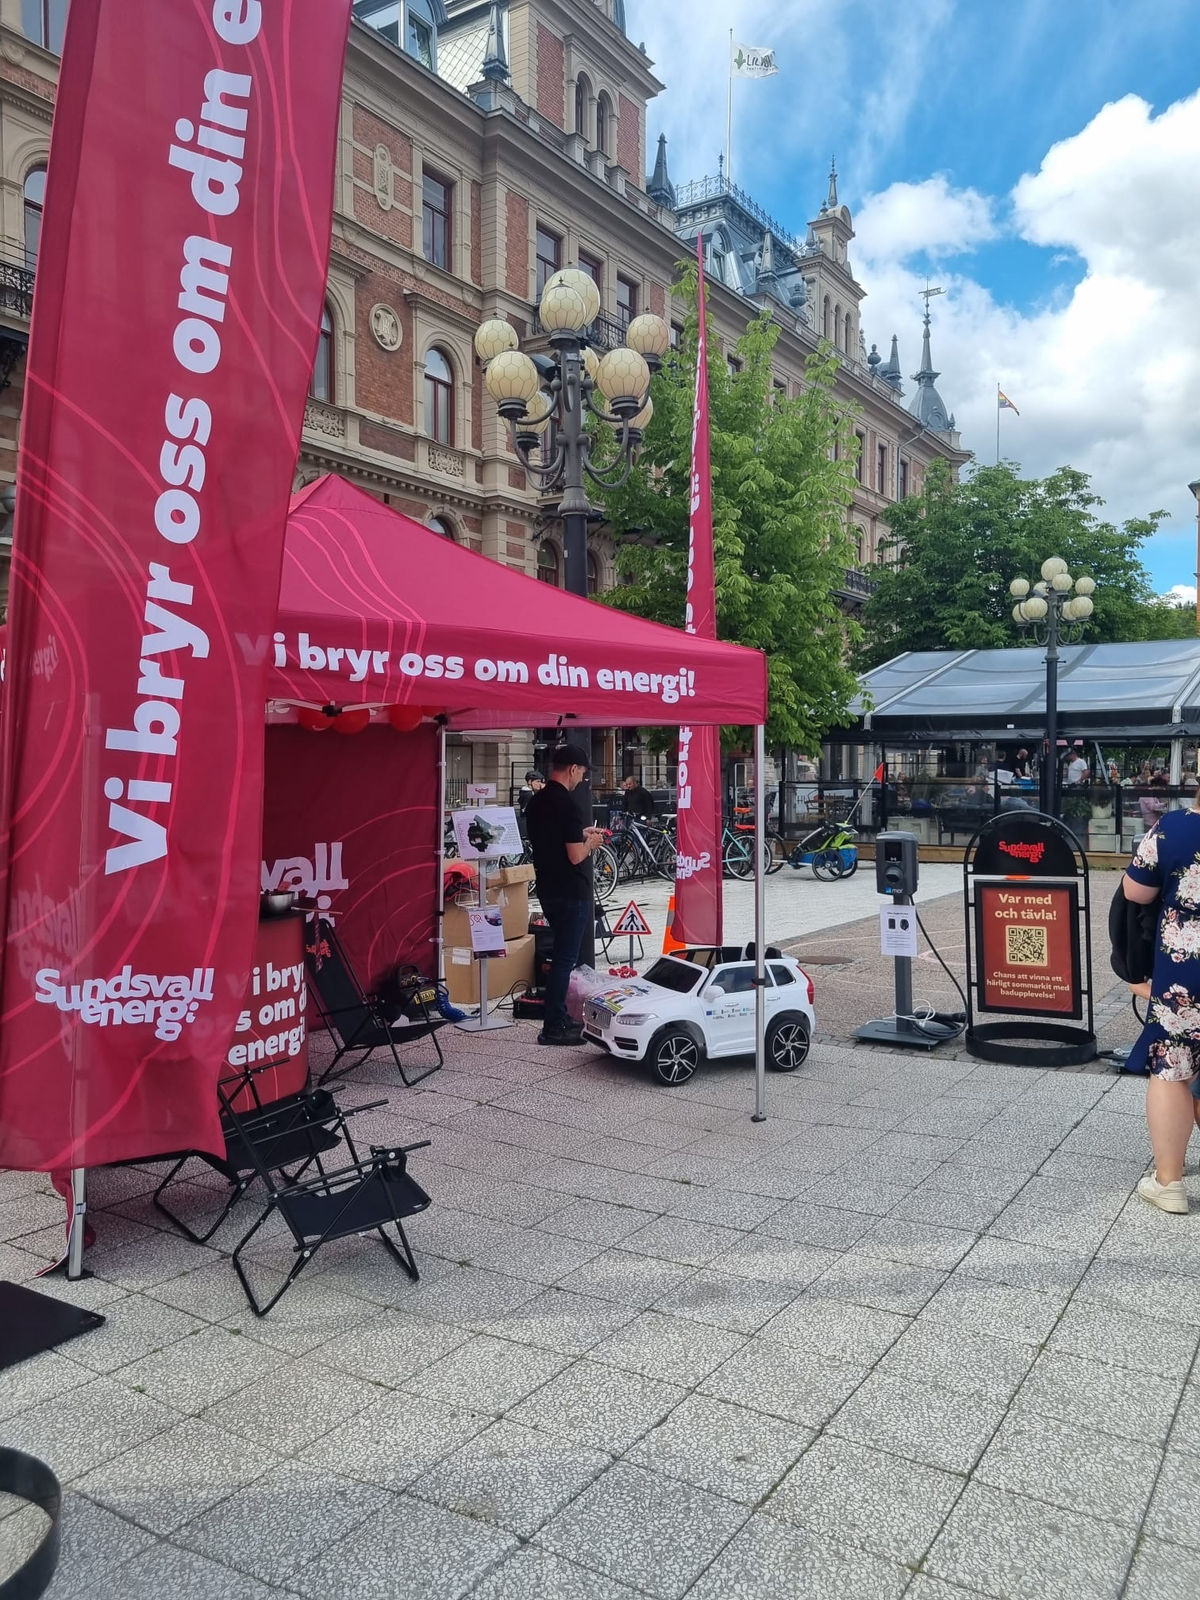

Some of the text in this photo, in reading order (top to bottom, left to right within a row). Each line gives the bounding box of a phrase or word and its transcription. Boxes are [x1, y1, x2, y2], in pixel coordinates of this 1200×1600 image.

[168, 69, 253, 216] din
[173, 235, 233, 374] om
[154, 393, 212, 544] oss
[106, 562, 210, 756] bryr
[298, 632, 390, 682] bryr
[400, 653, 465, 679] oss
[475, 658, 529, 684] om
[537, 654, 590, 688] din
[596, 667, 696, 704] energi!
[104, 777, 171, 876] Vi
[999, 841, 1045, 853] Sundsvall
[994, 908, 1057, 920] och tävla!
[998, 893, 1053, 905] Var med
[35, 965, 215, 1011] Sundsvall
[266, 962, 305, 994] bry
[986, 979, 1011, 988] härligt
[1012, 981, 1052, 990] sommarkit
[993, 971, 1016, 979] Chans
[1000, 988, 1056, 999] badupplevelse!
[80, 999, 199, 1042] energi
[258, 996, 297, 1027] om
